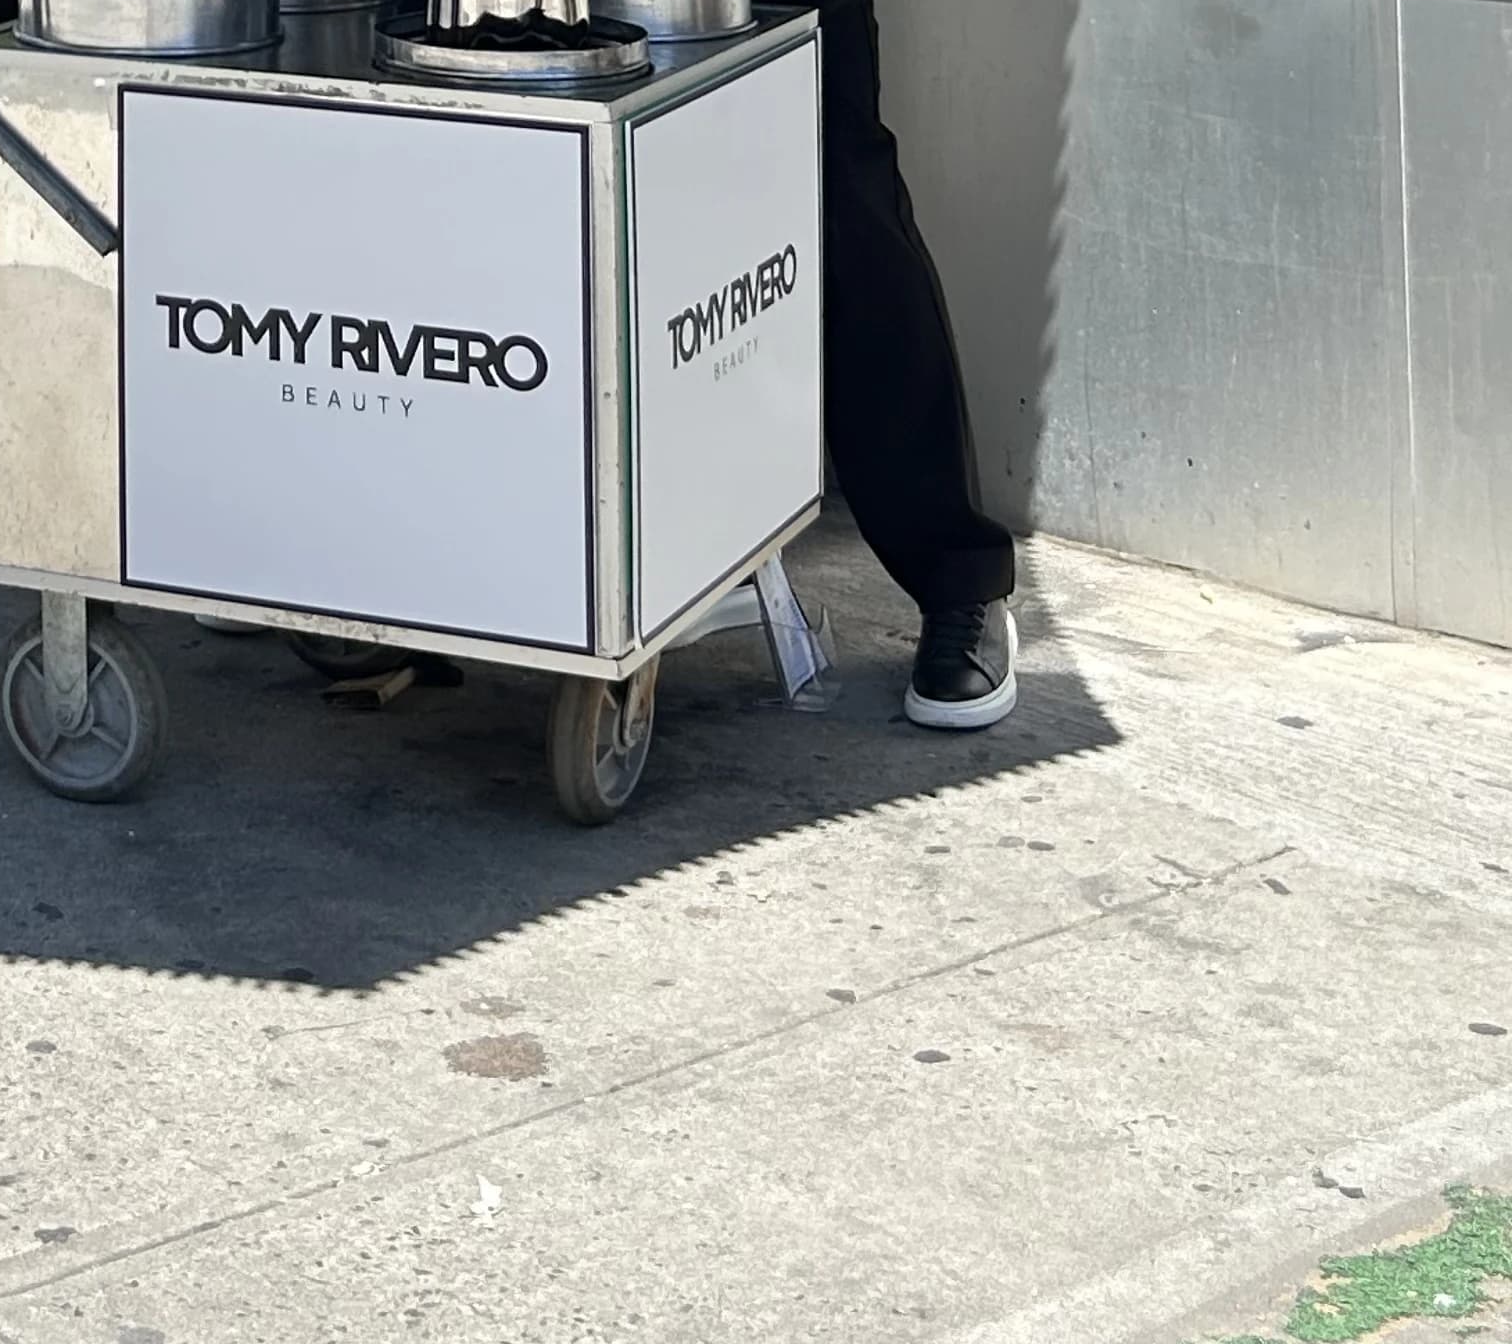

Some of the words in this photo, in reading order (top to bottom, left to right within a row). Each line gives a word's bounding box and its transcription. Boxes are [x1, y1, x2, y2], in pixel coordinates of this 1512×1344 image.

[667, 282, 730, 370] TOMY
[729, 243, 798, 330] RIVERO
[155, 294, 323, 365] TOMY
[330, 316, 549, 393] RIVERO
[712, 338, 760, 381] BEAUTY
[281, 383, 414, 418] BEAUTY
